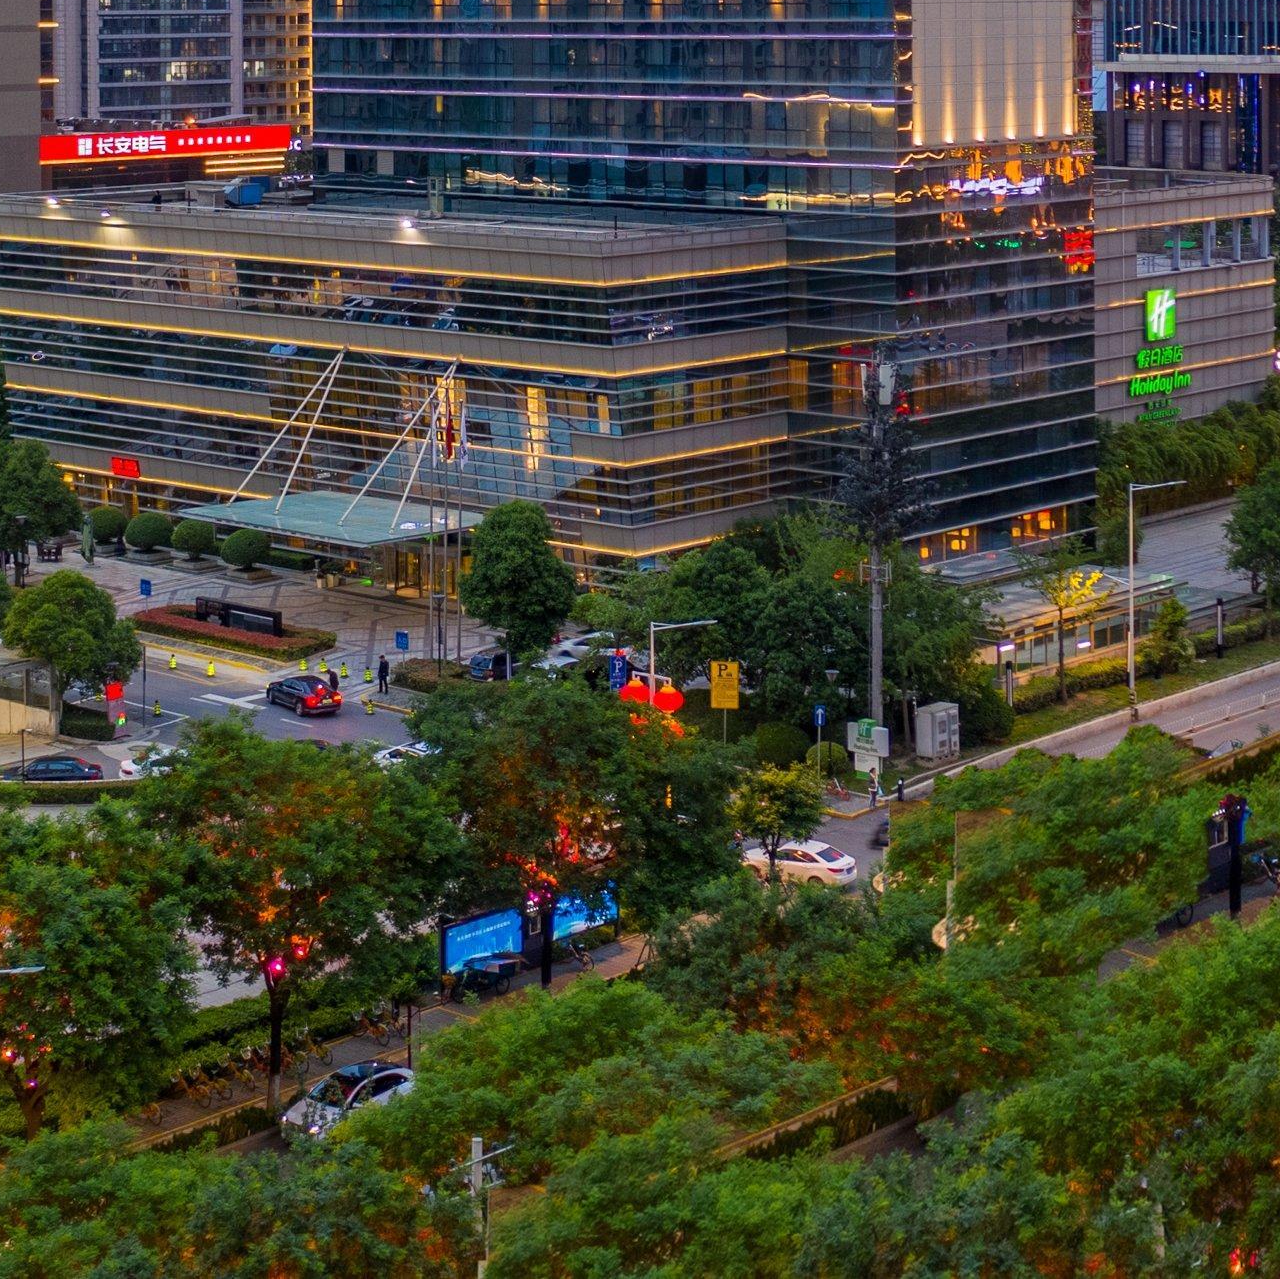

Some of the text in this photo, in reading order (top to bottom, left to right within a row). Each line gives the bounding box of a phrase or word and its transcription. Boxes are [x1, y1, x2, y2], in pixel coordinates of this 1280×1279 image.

[96, 134, 167, 155] 长安电气
[1136, 344, 1184, 369] 假日酒店
[1131, 369, 1192, 396] Holiday Inn
[615, 661, 624, 673] P
[717, 663, 729, 677] P
